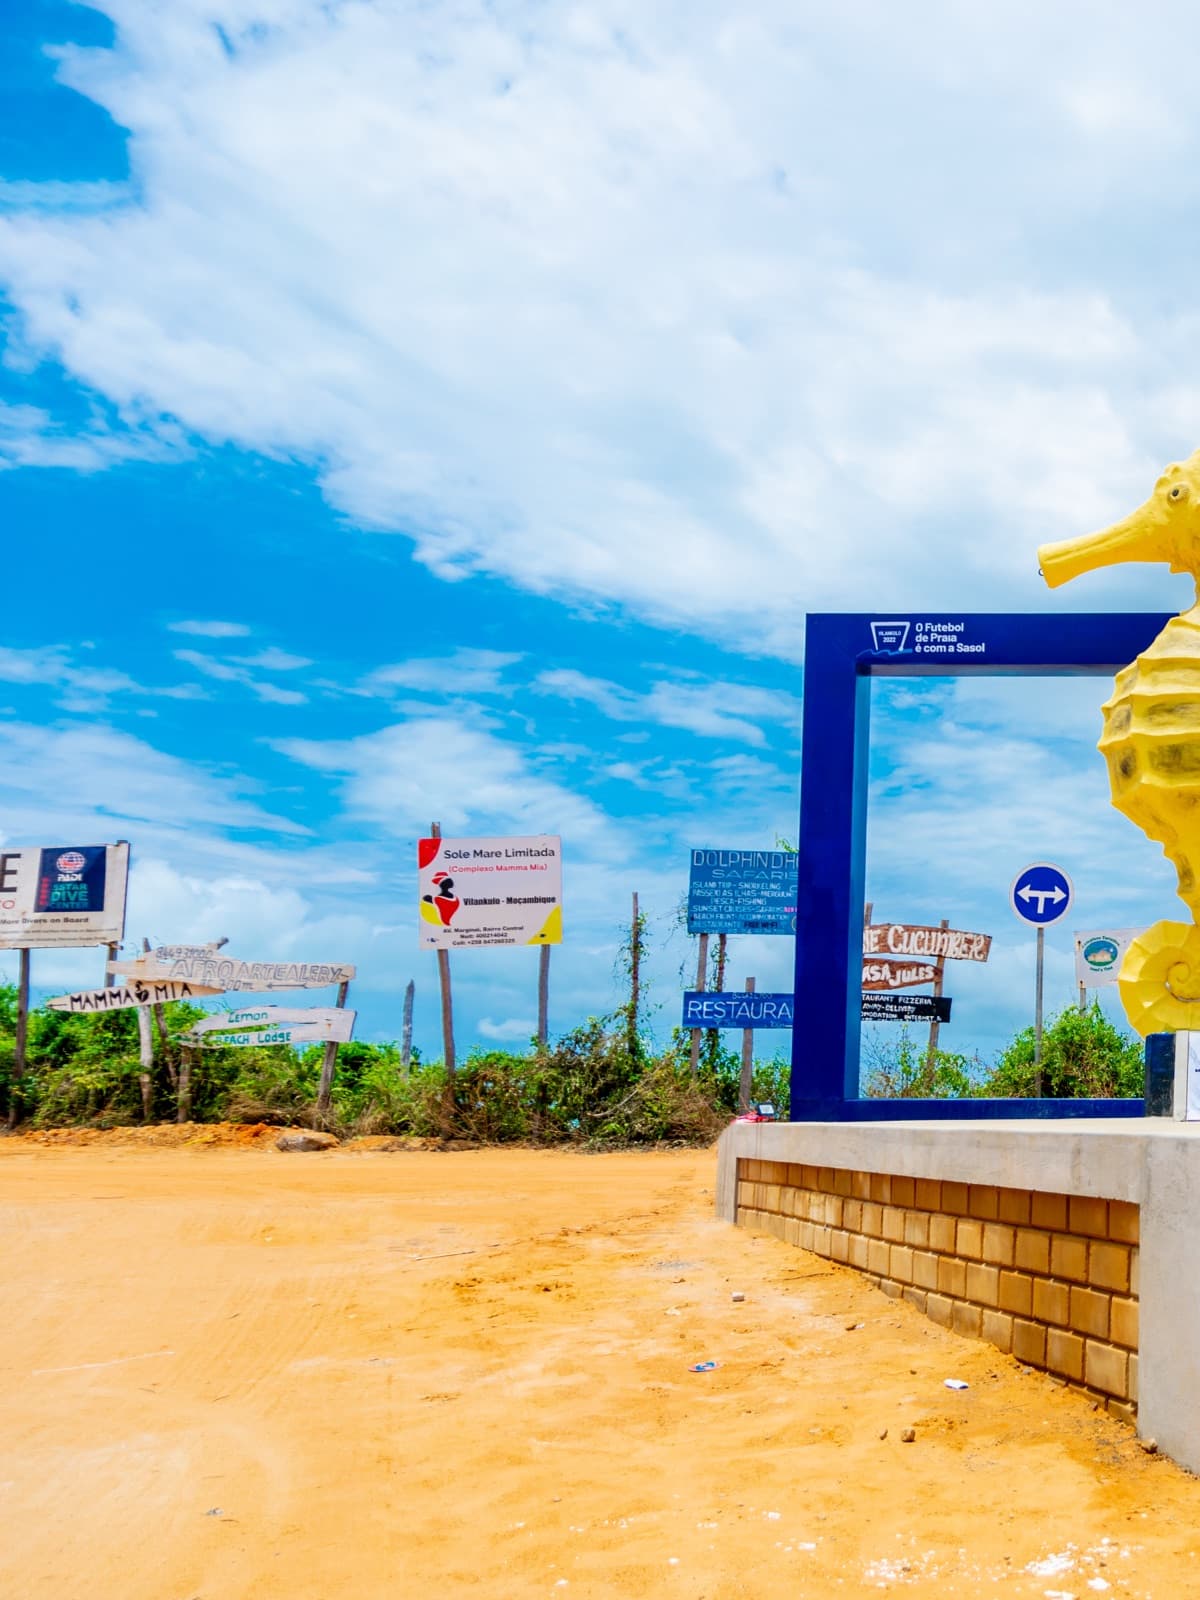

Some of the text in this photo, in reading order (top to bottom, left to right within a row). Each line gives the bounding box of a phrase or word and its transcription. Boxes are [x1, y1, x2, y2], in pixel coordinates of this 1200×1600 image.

[915, 622, 964, 632] O Futebol
[915, 633, 957, 643] de Praia
[923, 645, 947, 653] com
[948, 645, 955, 653] a
[956, 642, 985, 653] Sasol
[444, 847, 555, 859] Sole Mare Limitada
[693, 850, 799, 869] DOLPHIN DH
[448, 863, 548, 873] (Complexo Mamma Mia)
[57, 873, 83, 881] PADI
[711, 869, 799, 880] SAFARIS
[50, 891, 88, 901] DIVE
[506, 896, 556, 906] Moçambique
[889, 966, 934, 986] JULES
[70, 982, 192, 1010] MAMMA MIA
[687, 1001, 794, 1019] RESTAURA
